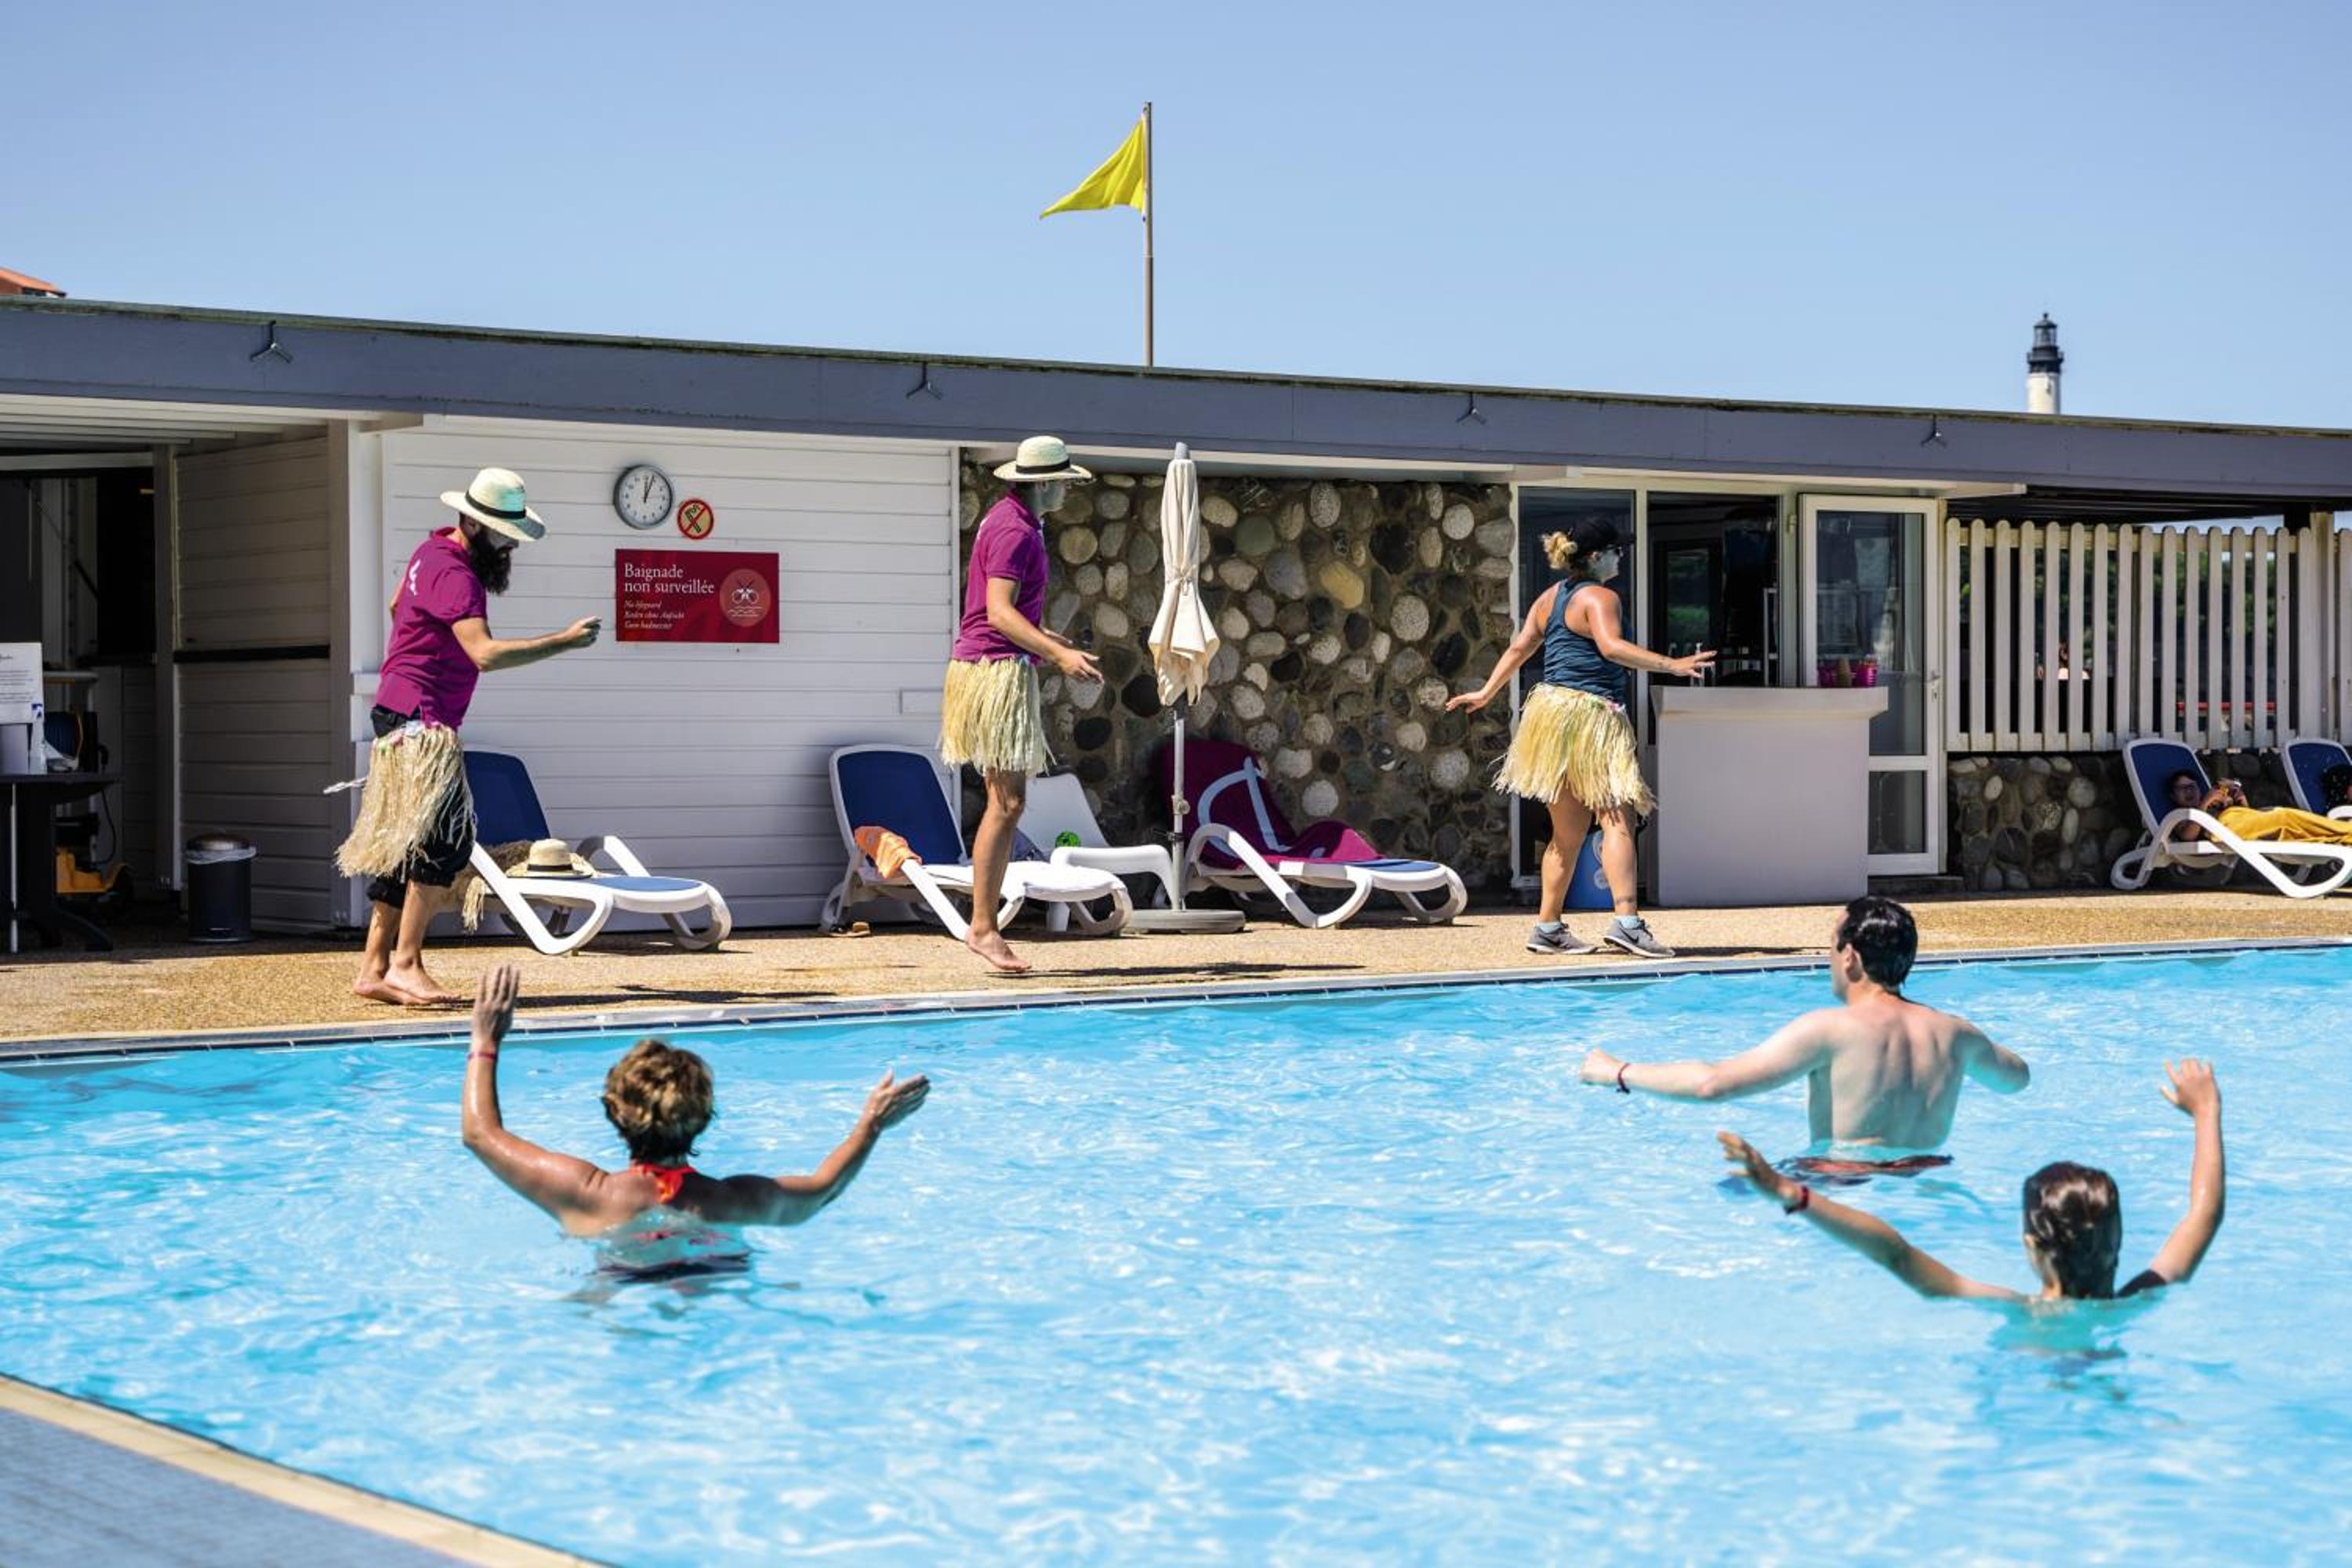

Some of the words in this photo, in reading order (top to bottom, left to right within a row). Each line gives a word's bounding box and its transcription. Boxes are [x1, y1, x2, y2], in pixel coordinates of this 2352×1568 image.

[625, 563, 684, 582] Baignade
[625, 583, 650, 593] non
[655, 579, 715, 593] surveillée
